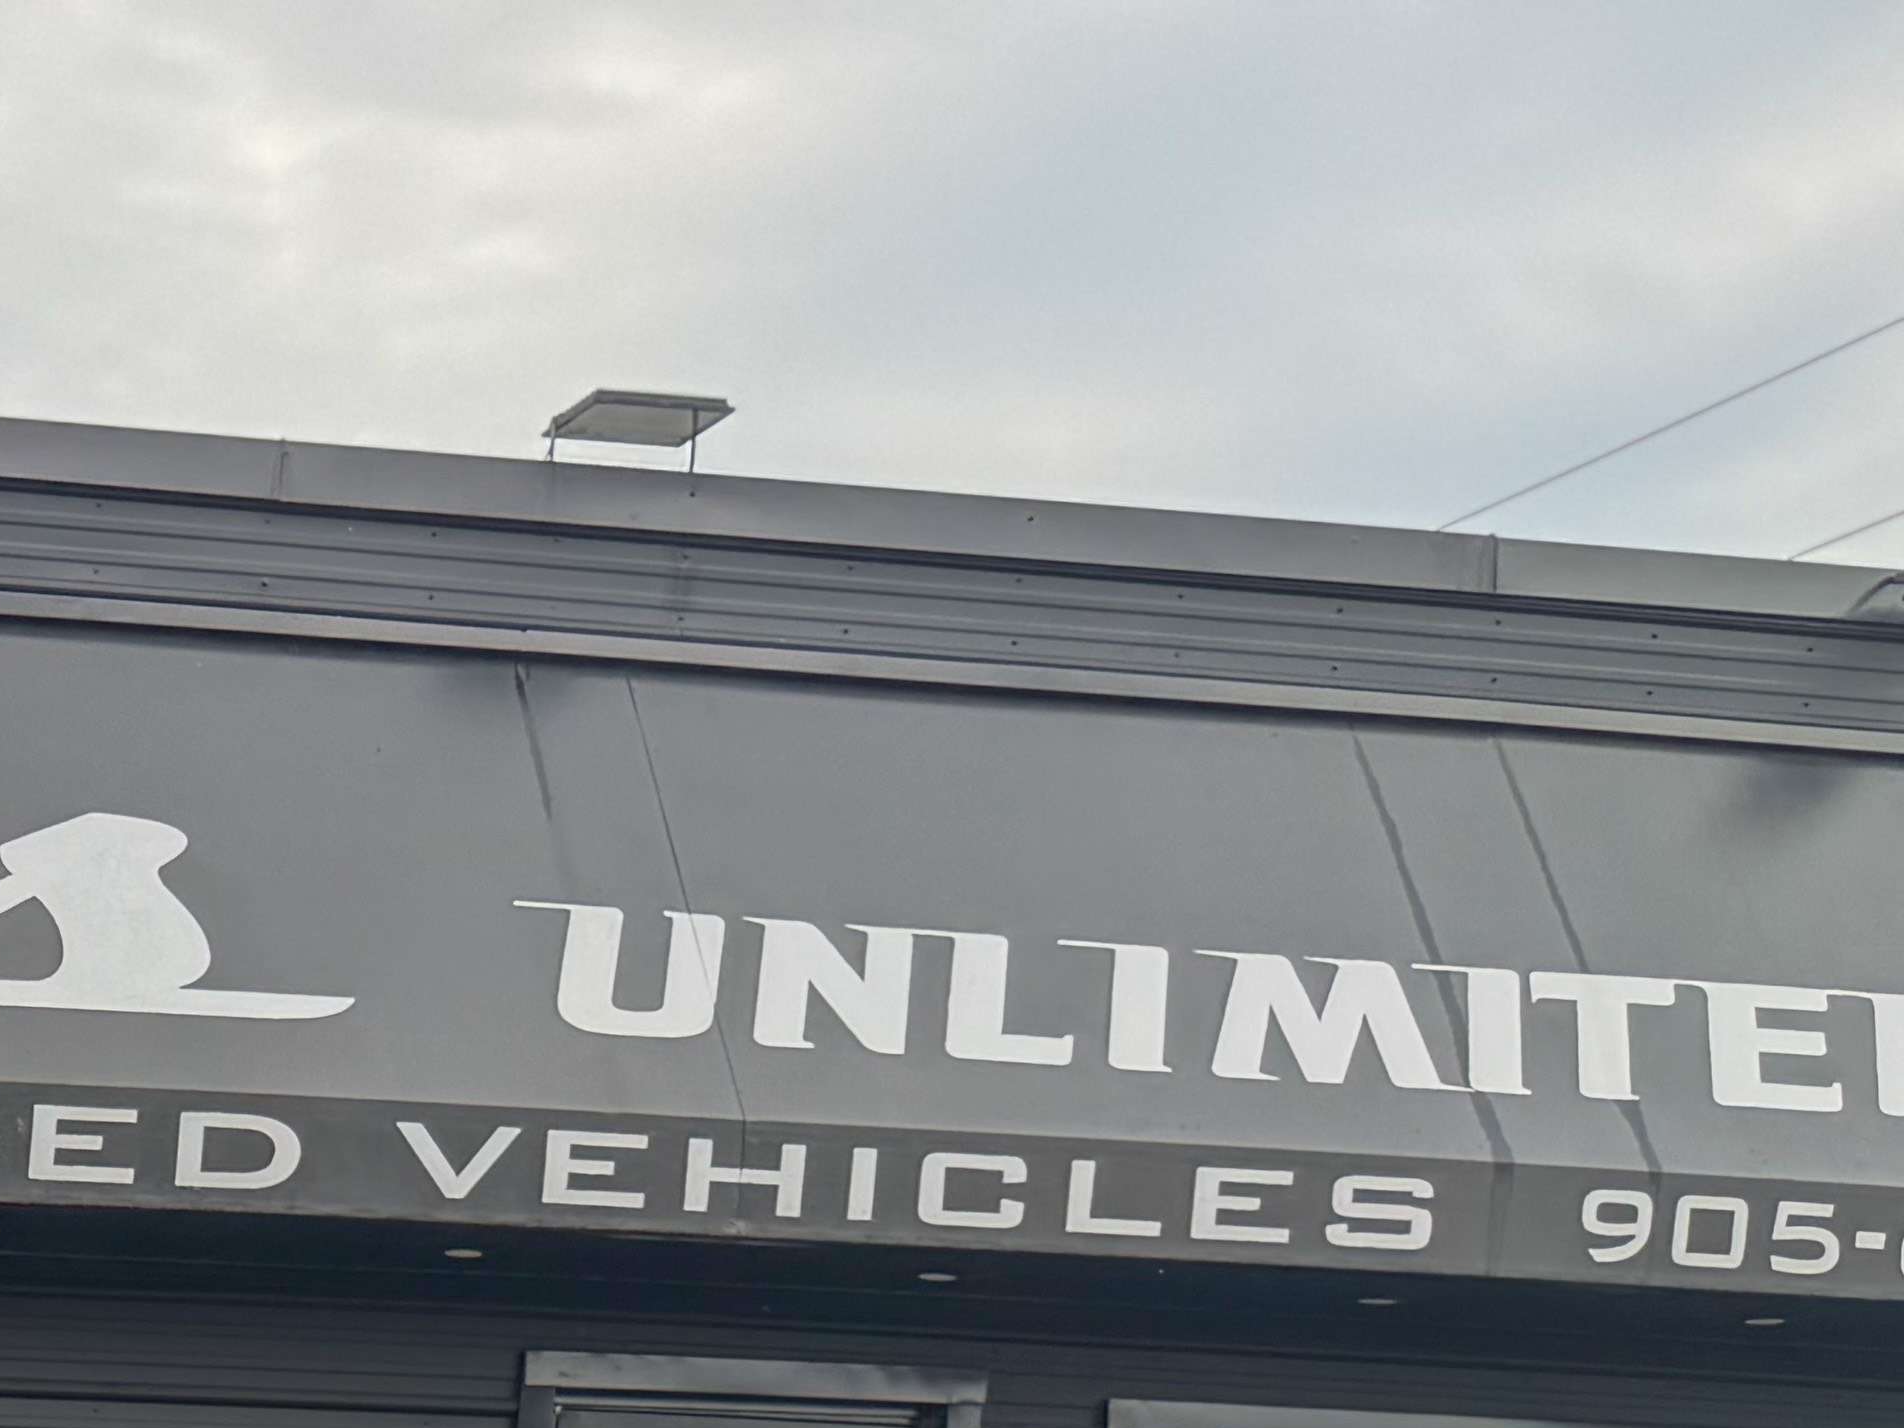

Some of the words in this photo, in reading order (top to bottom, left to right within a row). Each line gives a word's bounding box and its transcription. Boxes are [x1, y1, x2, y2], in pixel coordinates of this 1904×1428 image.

[513, 900, 1904, 1117] UNLIMITE
[396, 1121, 1434, 1250] VEHICLES
[1581, 1189, 1904, 1275] 905-
